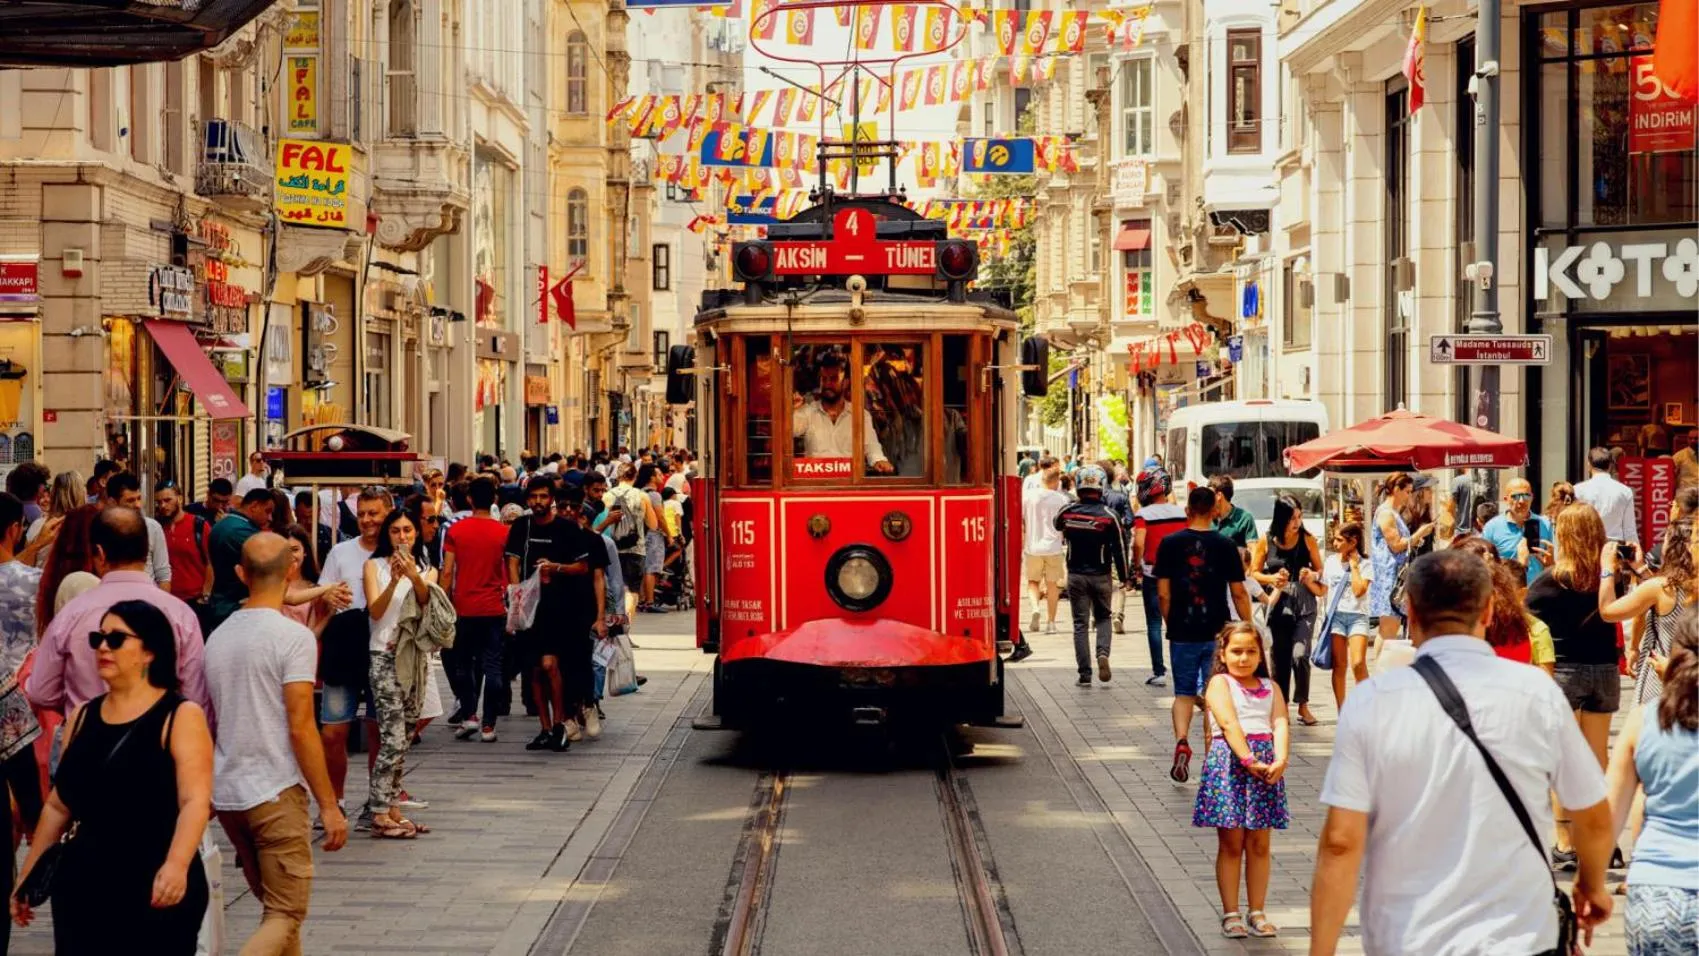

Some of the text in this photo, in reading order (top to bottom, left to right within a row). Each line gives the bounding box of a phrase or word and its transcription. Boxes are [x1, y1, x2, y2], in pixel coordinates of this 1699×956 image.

[282, 143, 344, 173] FAL
[845, 211, 859, 236] 4
[774, 244, 827, 269] AKSİM
[885, 243, 936, 269] TÜNEL
[0, 277, 34, 287] AKKAPI
[1456, 340, 1532, 348] Madame Tussauds
[1476, 349, 1511, 359] İstanbul
[213, 458, 233, 475] 50
[795, 460, 851, 473] TAKSİM
[1651, 464, 1669, 546] NDİRİM
[731, 520, 755, 545] 115
[961, 516, 985, 542] 115
